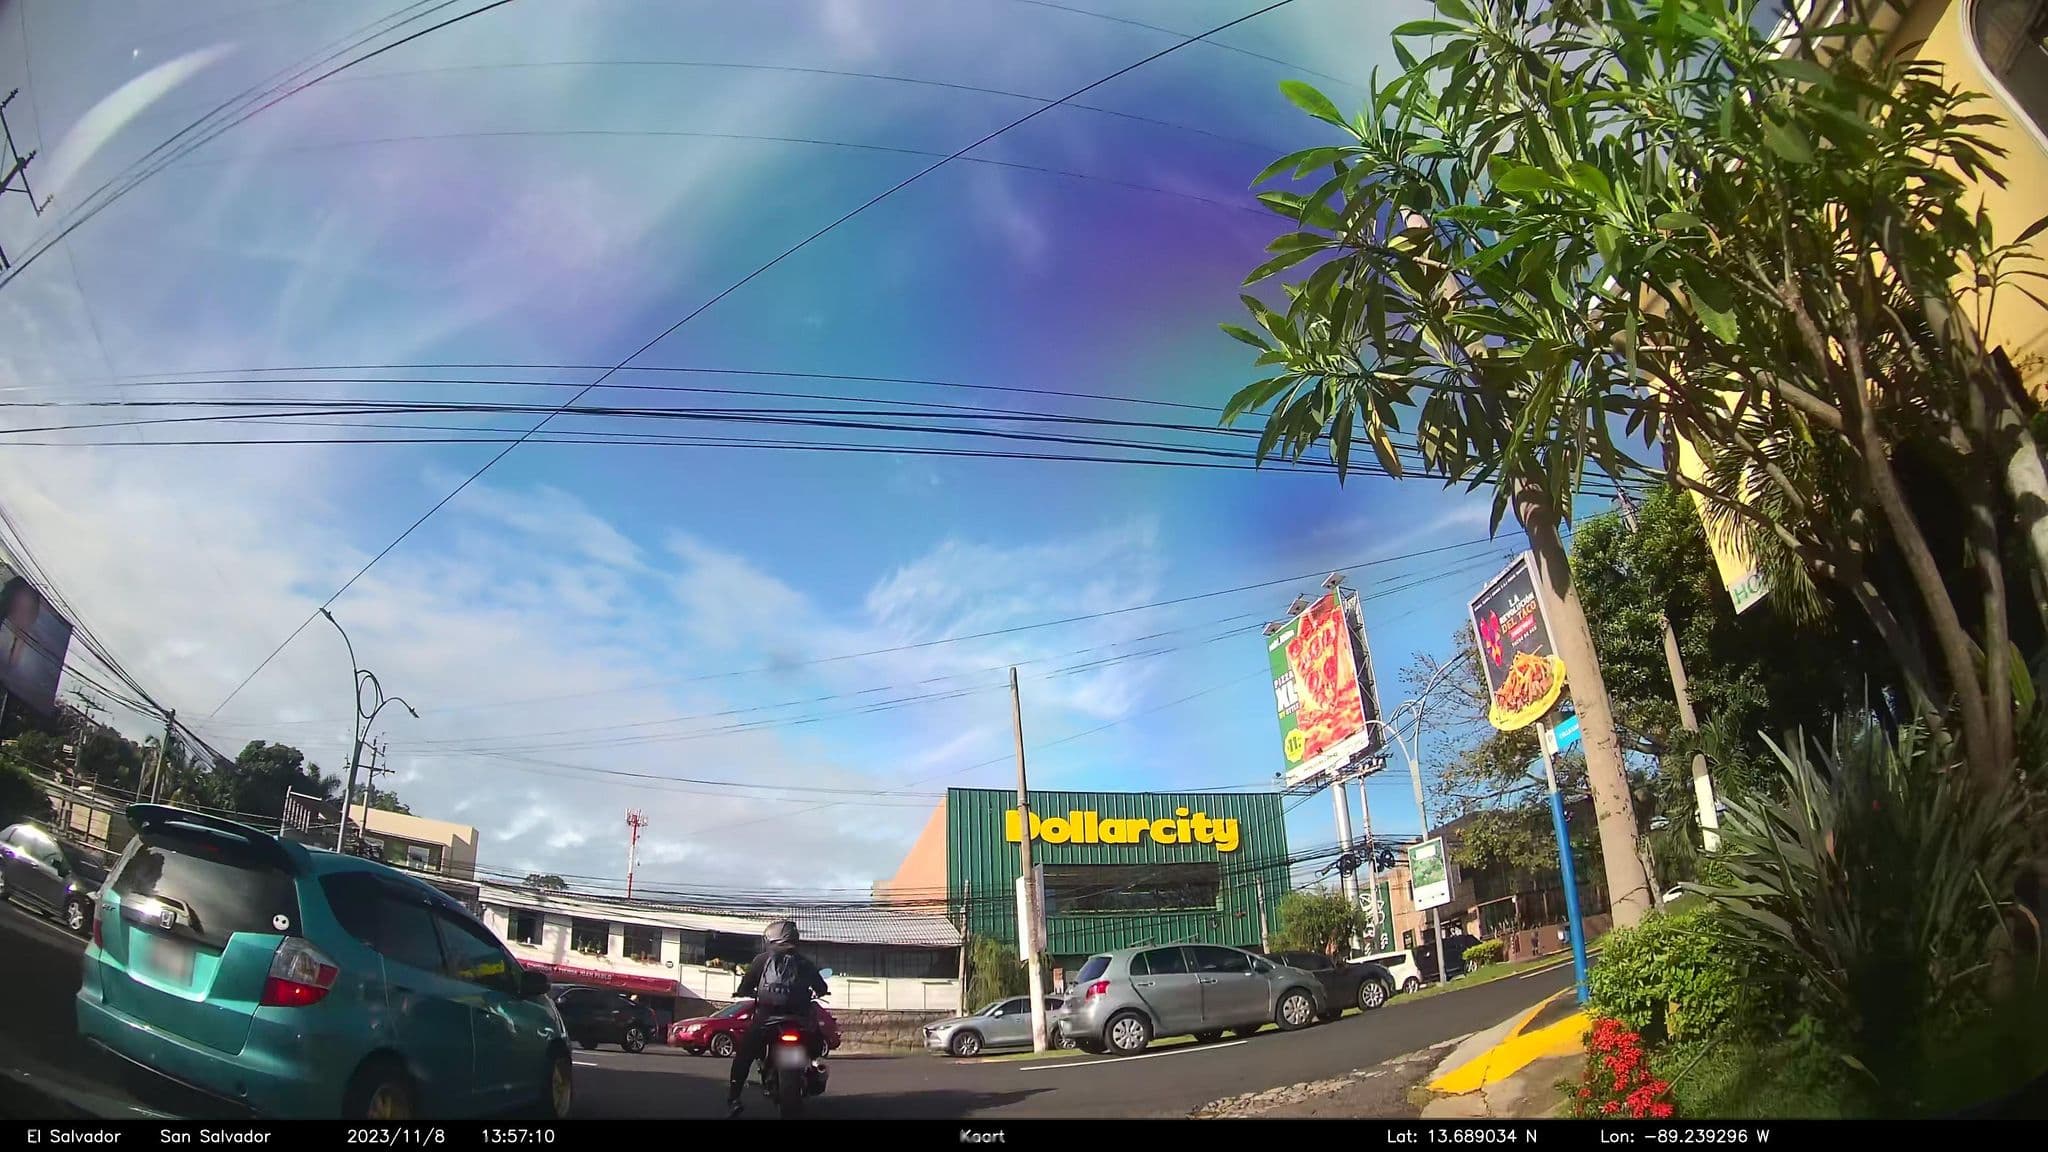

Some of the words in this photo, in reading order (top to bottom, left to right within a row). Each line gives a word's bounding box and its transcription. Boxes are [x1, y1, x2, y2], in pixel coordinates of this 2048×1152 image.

[1501, 618, 1518, 635] DEL
[1518, 600, 1537, 621] TACO
[1508, 594, 1520, 608] LA
[1274, 670, 1294, 689] PIZZA
[1276, 681, 1299, 714] XL
[1005, 808, 1239, 852] Dollarcity
